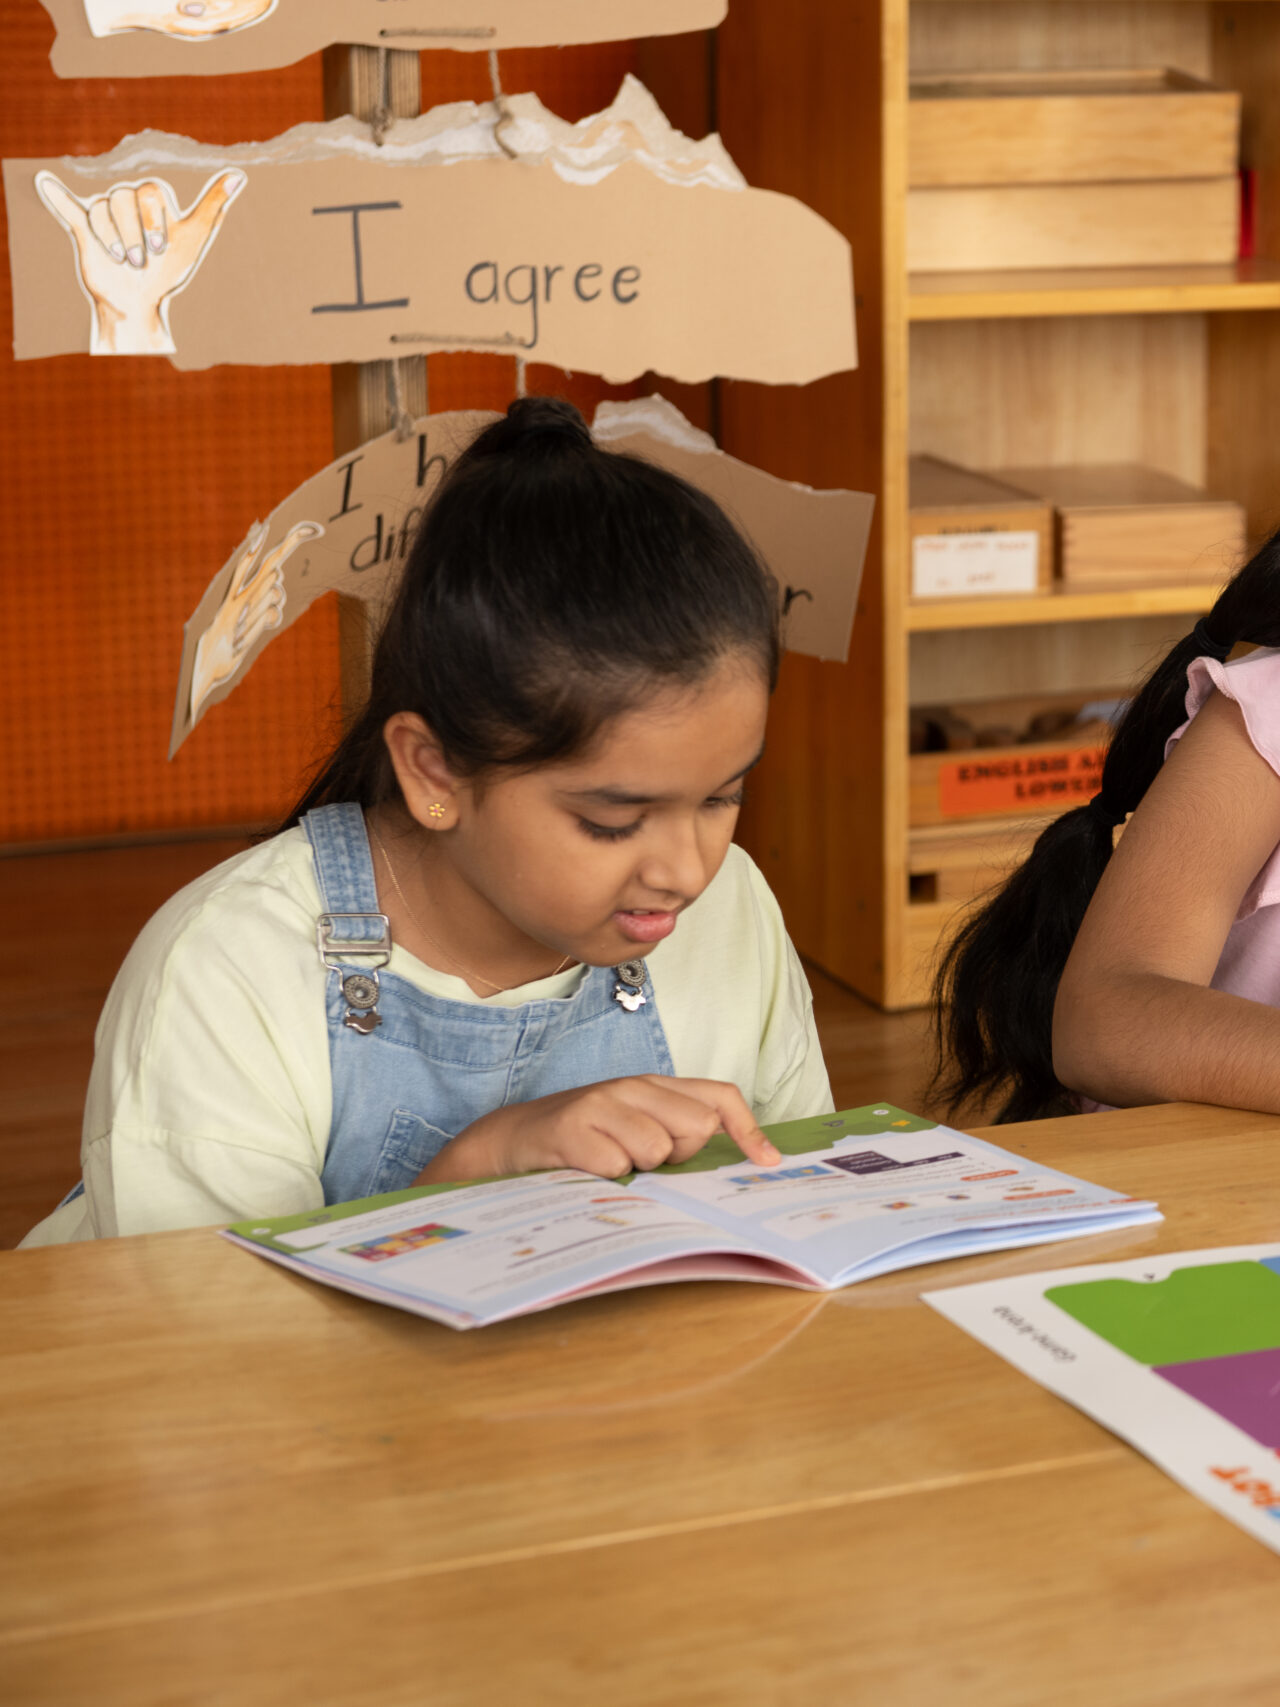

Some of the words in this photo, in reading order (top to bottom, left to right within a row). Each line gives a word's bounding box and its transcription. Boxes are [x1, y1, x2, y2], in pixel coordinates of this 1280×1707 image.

[312, 201, 409, 313] I
[465, 261, 641, 349] agree
[329, 455, 364, 523] I
[958, 756, 1070, 784] ENGLISH
